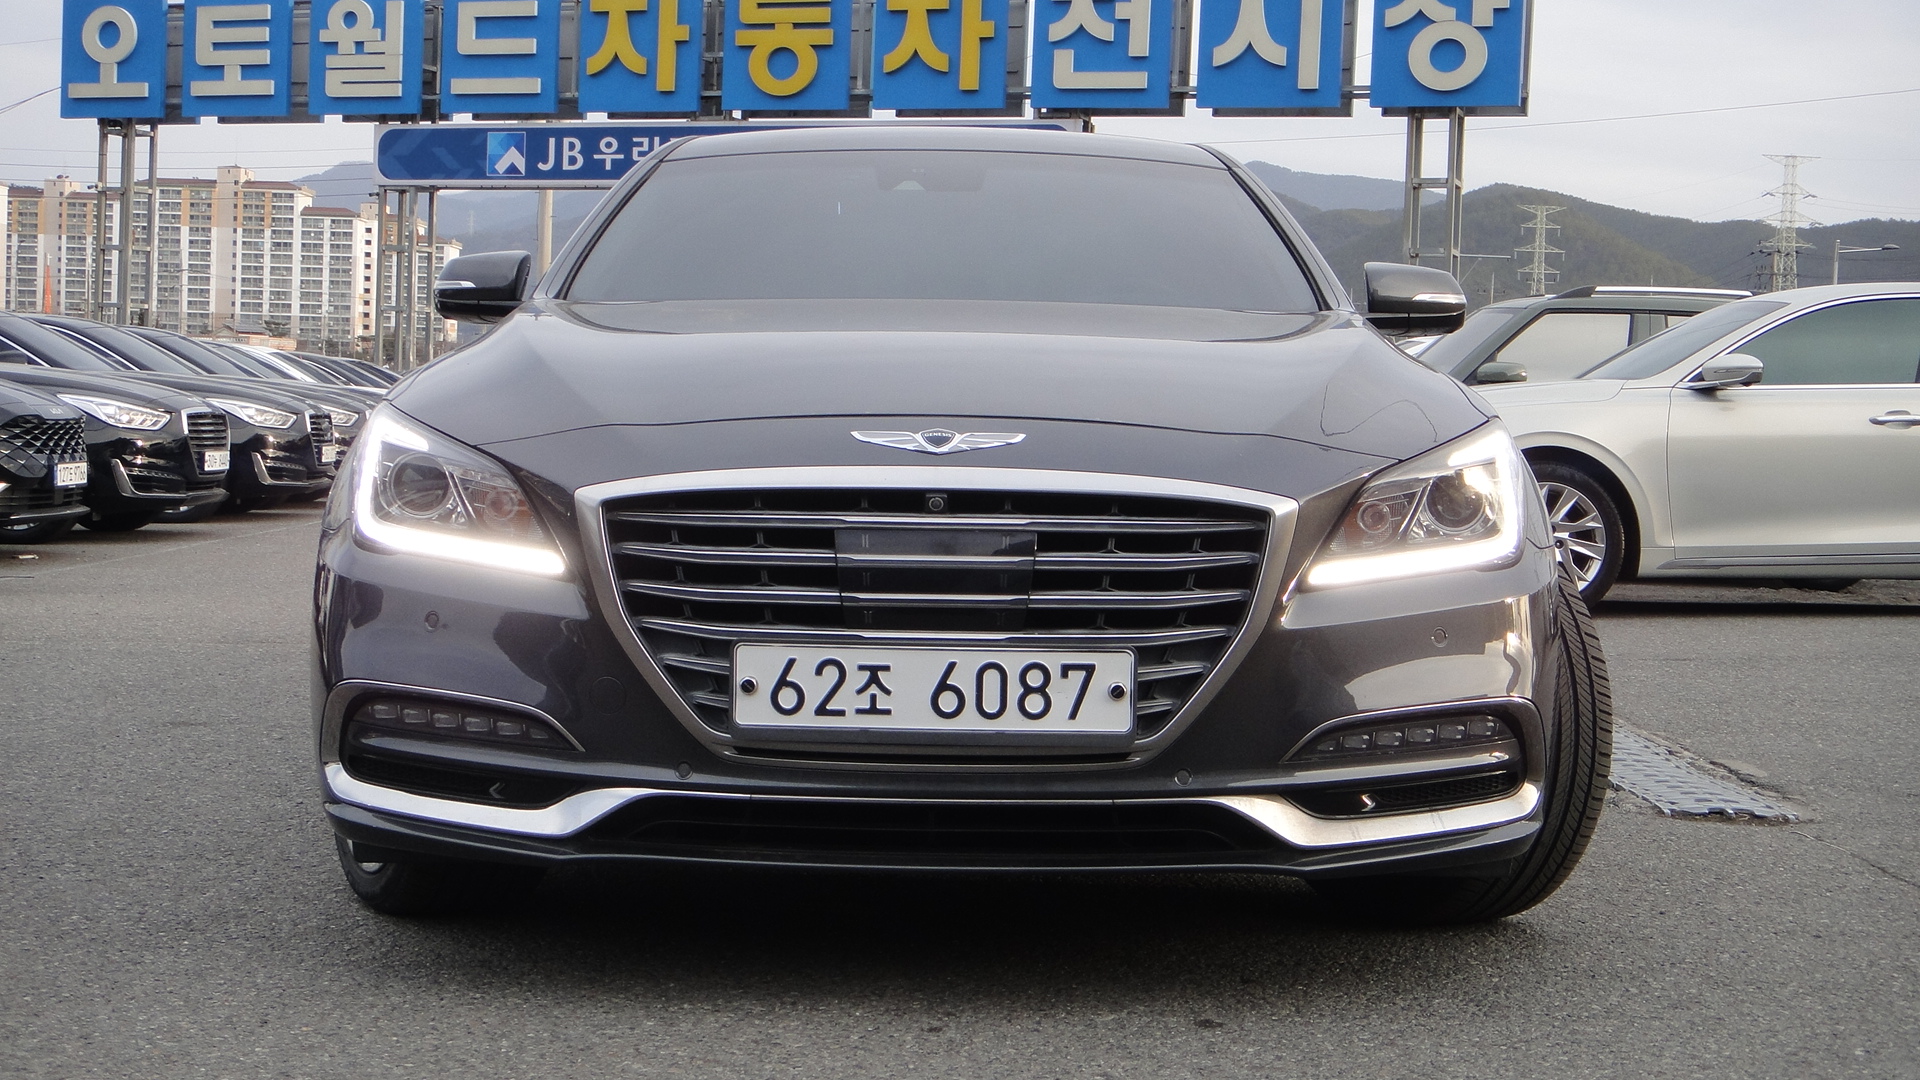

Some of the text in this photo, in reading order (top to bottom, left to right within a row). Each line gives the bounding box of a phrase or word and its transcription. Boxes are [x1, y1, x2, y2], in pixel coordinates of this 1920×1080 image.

[67, 0, 542, 98] 오토월드
[769, 656, 1097, 721] 62조 6087
